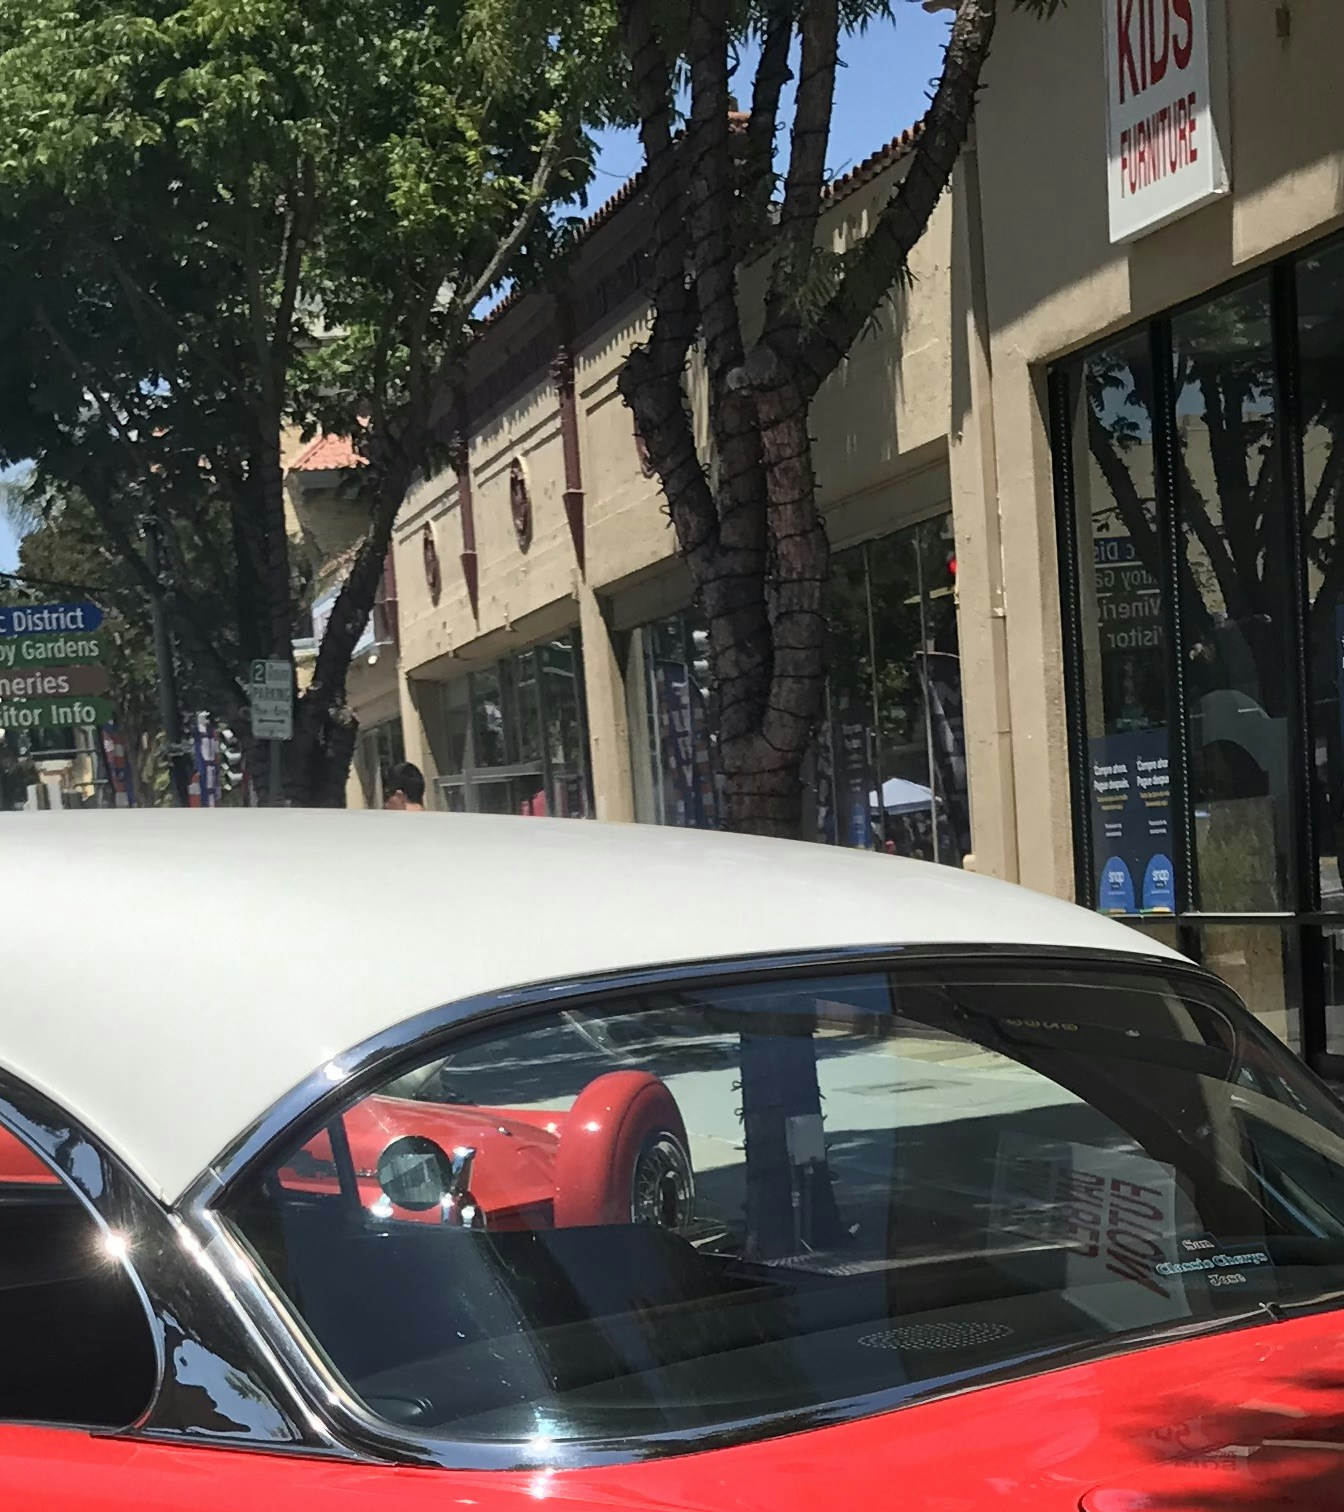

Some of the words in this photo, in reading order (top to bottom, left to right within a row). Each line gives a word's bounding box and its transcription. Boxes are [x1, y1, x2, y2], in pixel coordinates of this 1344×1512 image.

[1117, 0, 1194, 105] KIDS
[1119, 91, 1198, 198] FURNITURE
[12, 607, 85, 632] District
[21, 637, 100, 660] Gardens
[51, 702, 96, 725] Info
